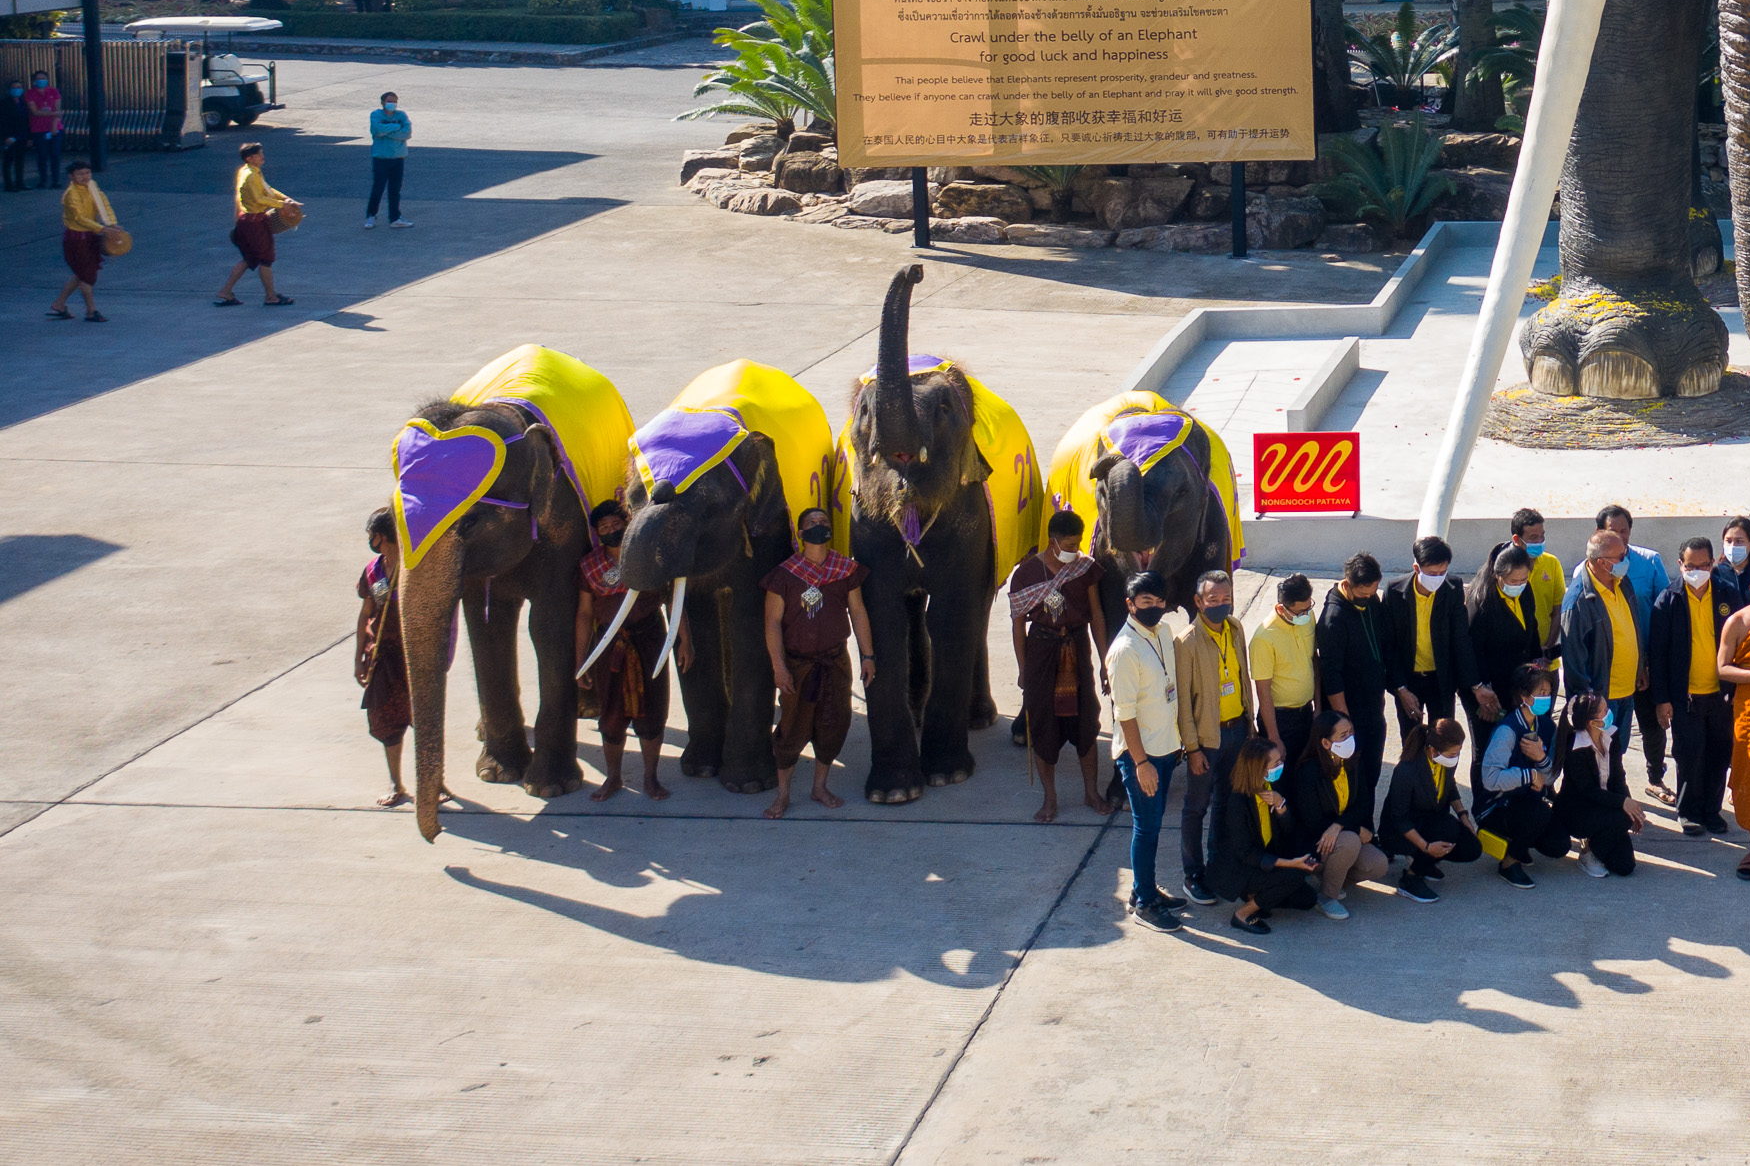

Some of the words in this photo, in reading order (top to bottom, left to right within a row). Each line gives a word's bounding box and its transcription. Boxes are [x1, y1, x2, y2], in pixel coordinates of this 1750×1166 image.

[950, 31, 986, 43] Crawl
[990, 31, 1029, 43] under
[1034, 30, 1056, 42] the
[1062, 30, 1094, 44] belly
[1099, 30, 1113, 41] of
[1117, 32, 1133, 41] an
[1138, 28, 1198, 43] Elephant
[979, 51, 998, 63] for
[1003, 51, 1036, 65] good
[1041, 50, 1068, 62] luck
[1073, 49, 1097, 61] and
[1102, 48, 1169, 63] happiness
[895, 76, 915, 85] Thai
[917, 76, 949, 86] people
[951, 75, 983, 84] believe
[986, 75, 1004, 84] that
[1007, 75, 1052, 85] Elephants
[1054, 74, 1097, 84] represent
[1100, 73, 1147, 84] prosperity,
[1149, 72, 1190, 82] grandeur
[1192, 72, 1210, 80] and
[1213, 71, 1257, 81] greatness.
[853, 94, 876, 103] They
[879, 93, 912, 101] believe
[914, 93, 920, 101] if
[923, 94, 956, 103] anyone
[977, 92, 1000, 101] crawl
[1003, 92, 1029, 100] under
[1033, 92, 1048, 100] the
[1051, 91, 1074, 101] belly
[1076, 91, 1086, 99] of
[1102, 89, 1142, 100] Elephant
[1145, 89, 1162, 98] and
[1165, 90, 1185, 99] pray
[1197, 88, 1213, 96] will
[1215, 88, 1233, 97] give
[1235, 87, 1258, 97] good
[1260, 86, 1299, 96] strength.
[969, 109, 1183, 126] 走过大象的腹部收获幸福和好运
[1014, 444, 1034, 515] 21
[1261, 498, 1314, 506] NONGNOOCH
